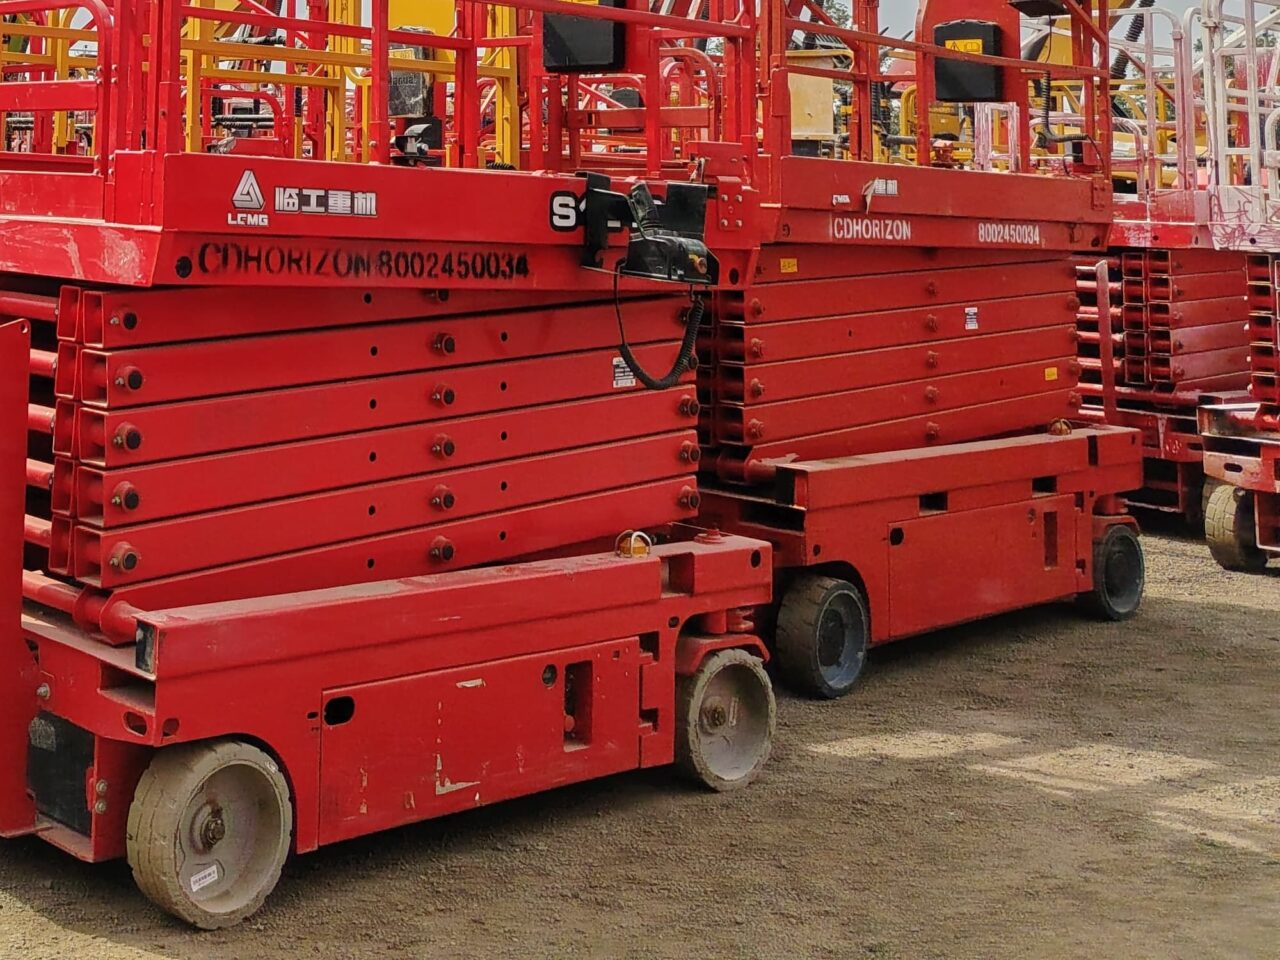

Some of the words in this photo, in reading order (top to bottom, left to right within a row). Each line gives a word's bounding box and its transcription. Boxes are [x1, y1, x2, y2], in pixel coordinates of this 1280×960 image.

[274, 187, 377, 216] 临工重机
[833, 217, 911, 240] CDHORIZON
[978, 222, 1040, 245] 8002450034
